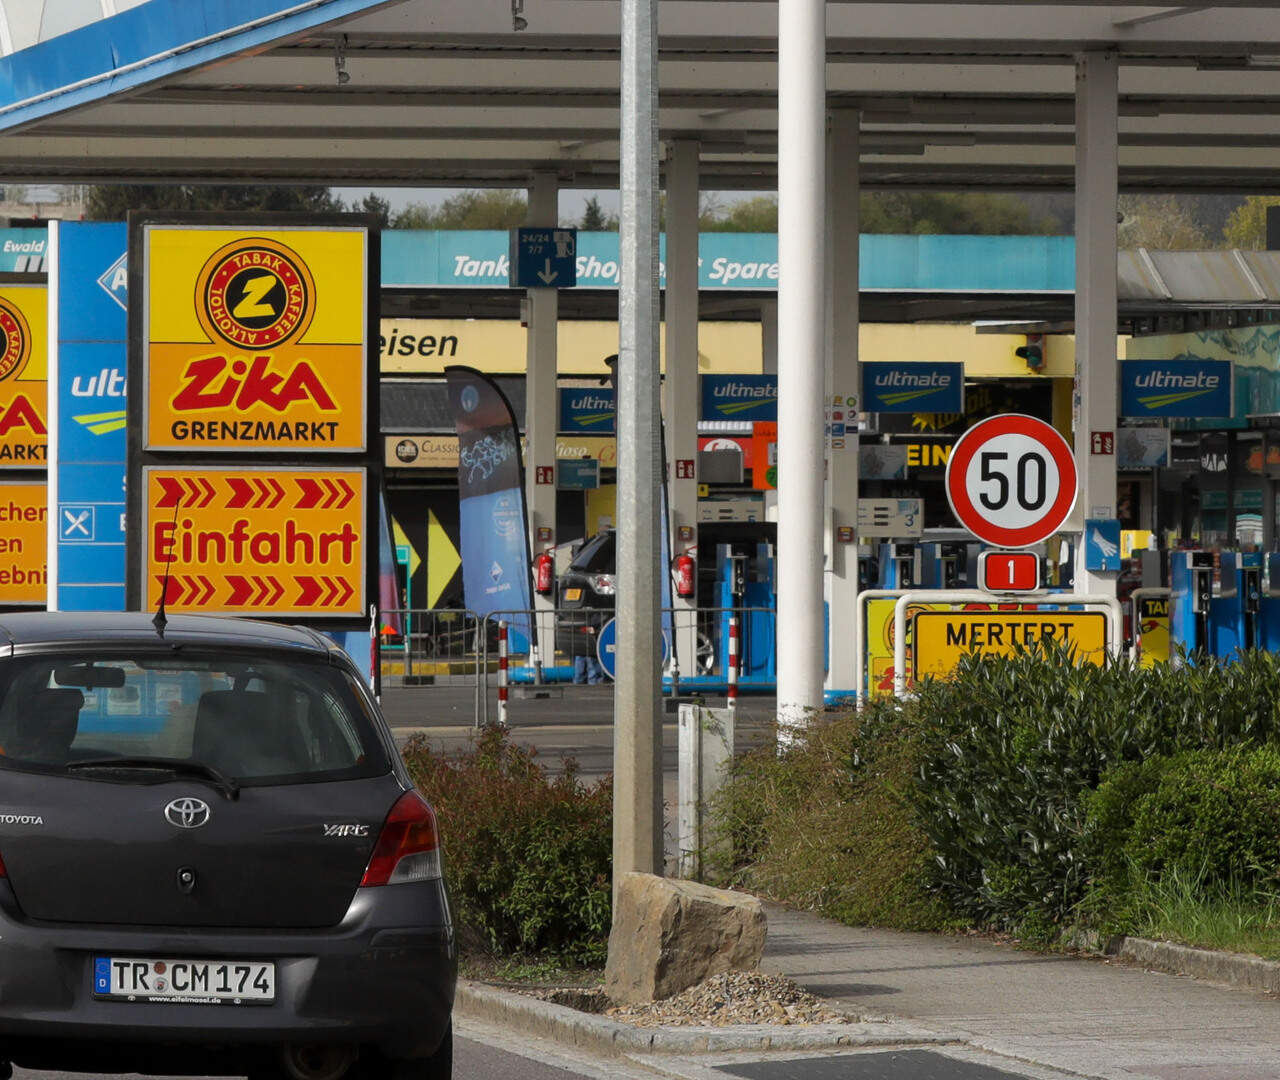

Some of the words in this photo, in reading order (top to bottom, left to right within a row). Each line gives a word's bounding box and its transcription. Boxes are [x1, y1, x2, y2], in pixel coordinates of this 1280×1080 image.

[3, 240, 45, 253] Ewald
[232, 253, 283, 271] TABAK
[454, 255, 510, 278] Tank
[708, 257, 779, 285] Spare
[210, 287, 257, 344] ALKOHOL
[275, 283, 302, 336] KAFFEE
[0, 330, 20, 375] KAFFEE
[875, 371, 951, 387] ultimate
[1135, 370, 1220, 388] ultimate
[171, 420, 339, 442] GRENZMARKT
[978, 450, 1048, 512] 50
[904, 514, 915, 527] 3
[153, 520, 360, 565] Einfahrt
[1007, 560, 1015, 585] 1
[947, 622, 1074, 648] MERTERT
[0, 814, 44, 825] TOYOTA
[99, 978, 106, 988] D
[113, 961, 150, 991] TR
[170, 963, 209, 992] CM
[215, 965, 269, 994] 174
